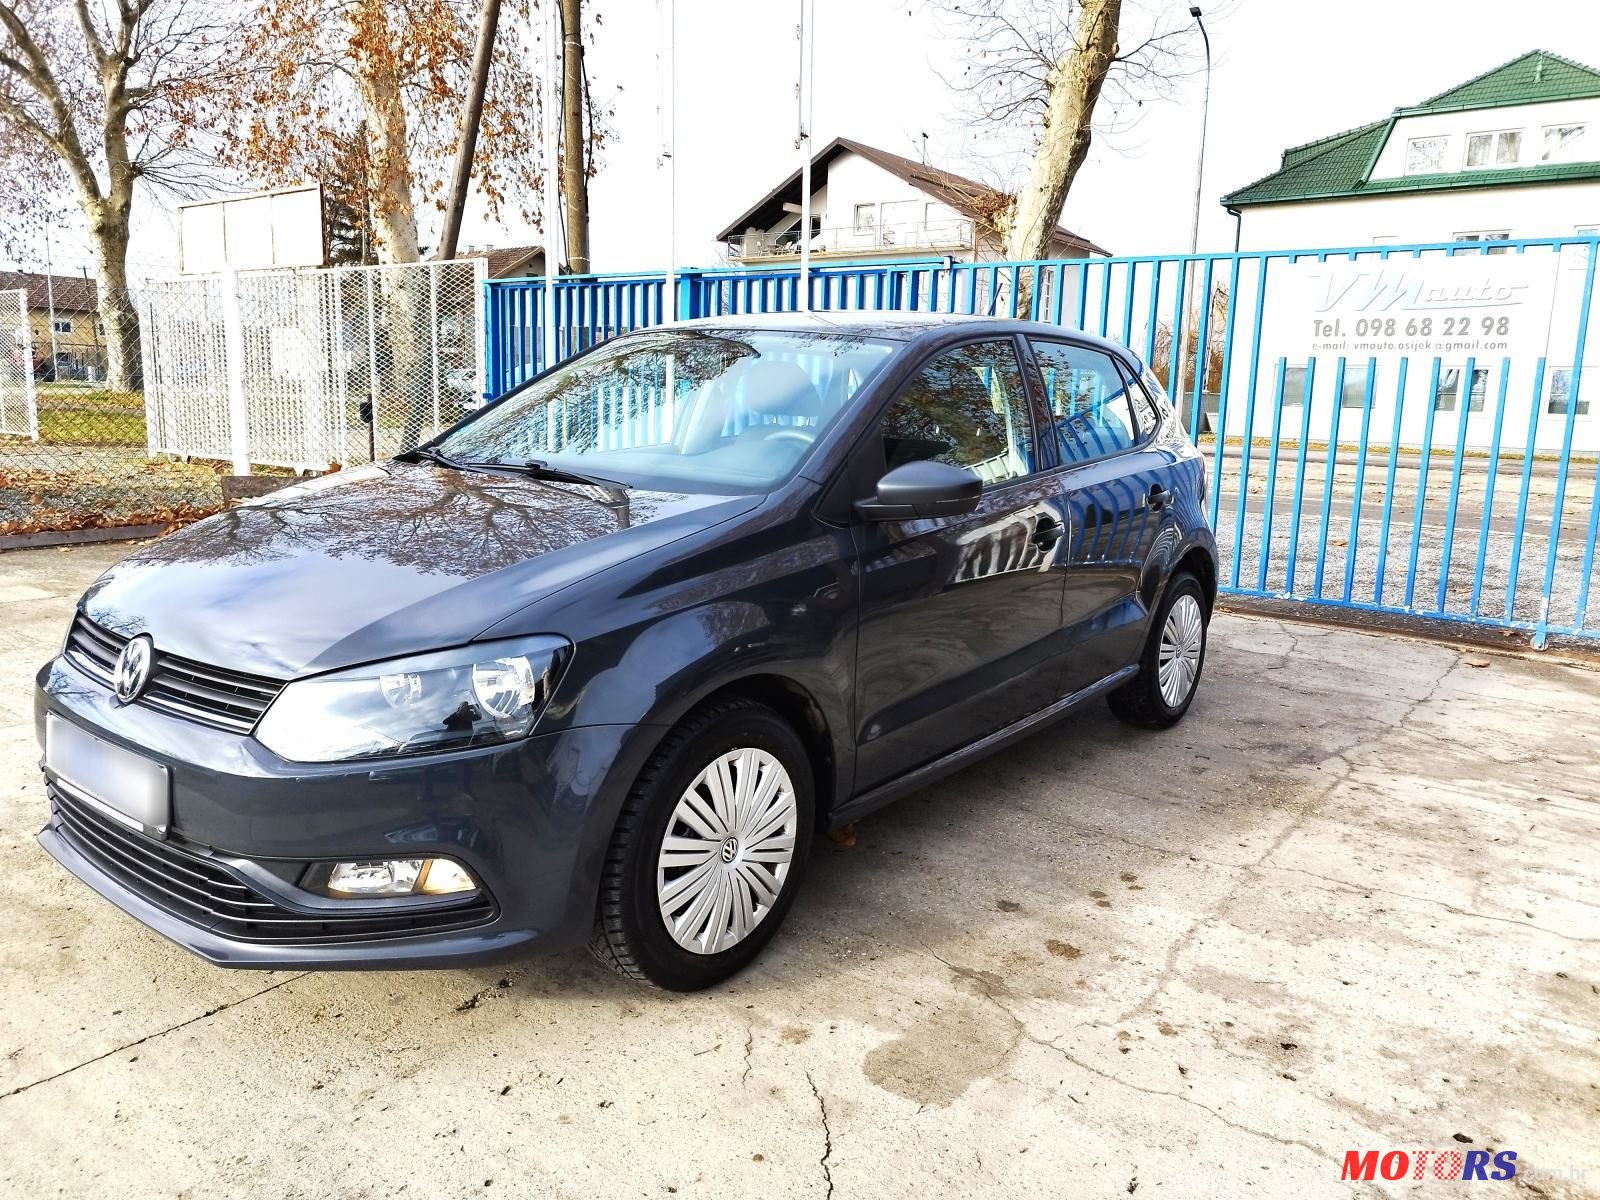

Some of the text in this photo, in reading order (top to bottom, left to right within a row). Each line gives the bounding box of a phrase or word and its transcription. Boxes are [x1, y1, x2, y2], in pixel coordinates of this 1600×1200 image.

[1313, 315, 1510, 337] Tel. 098 68 22 98
